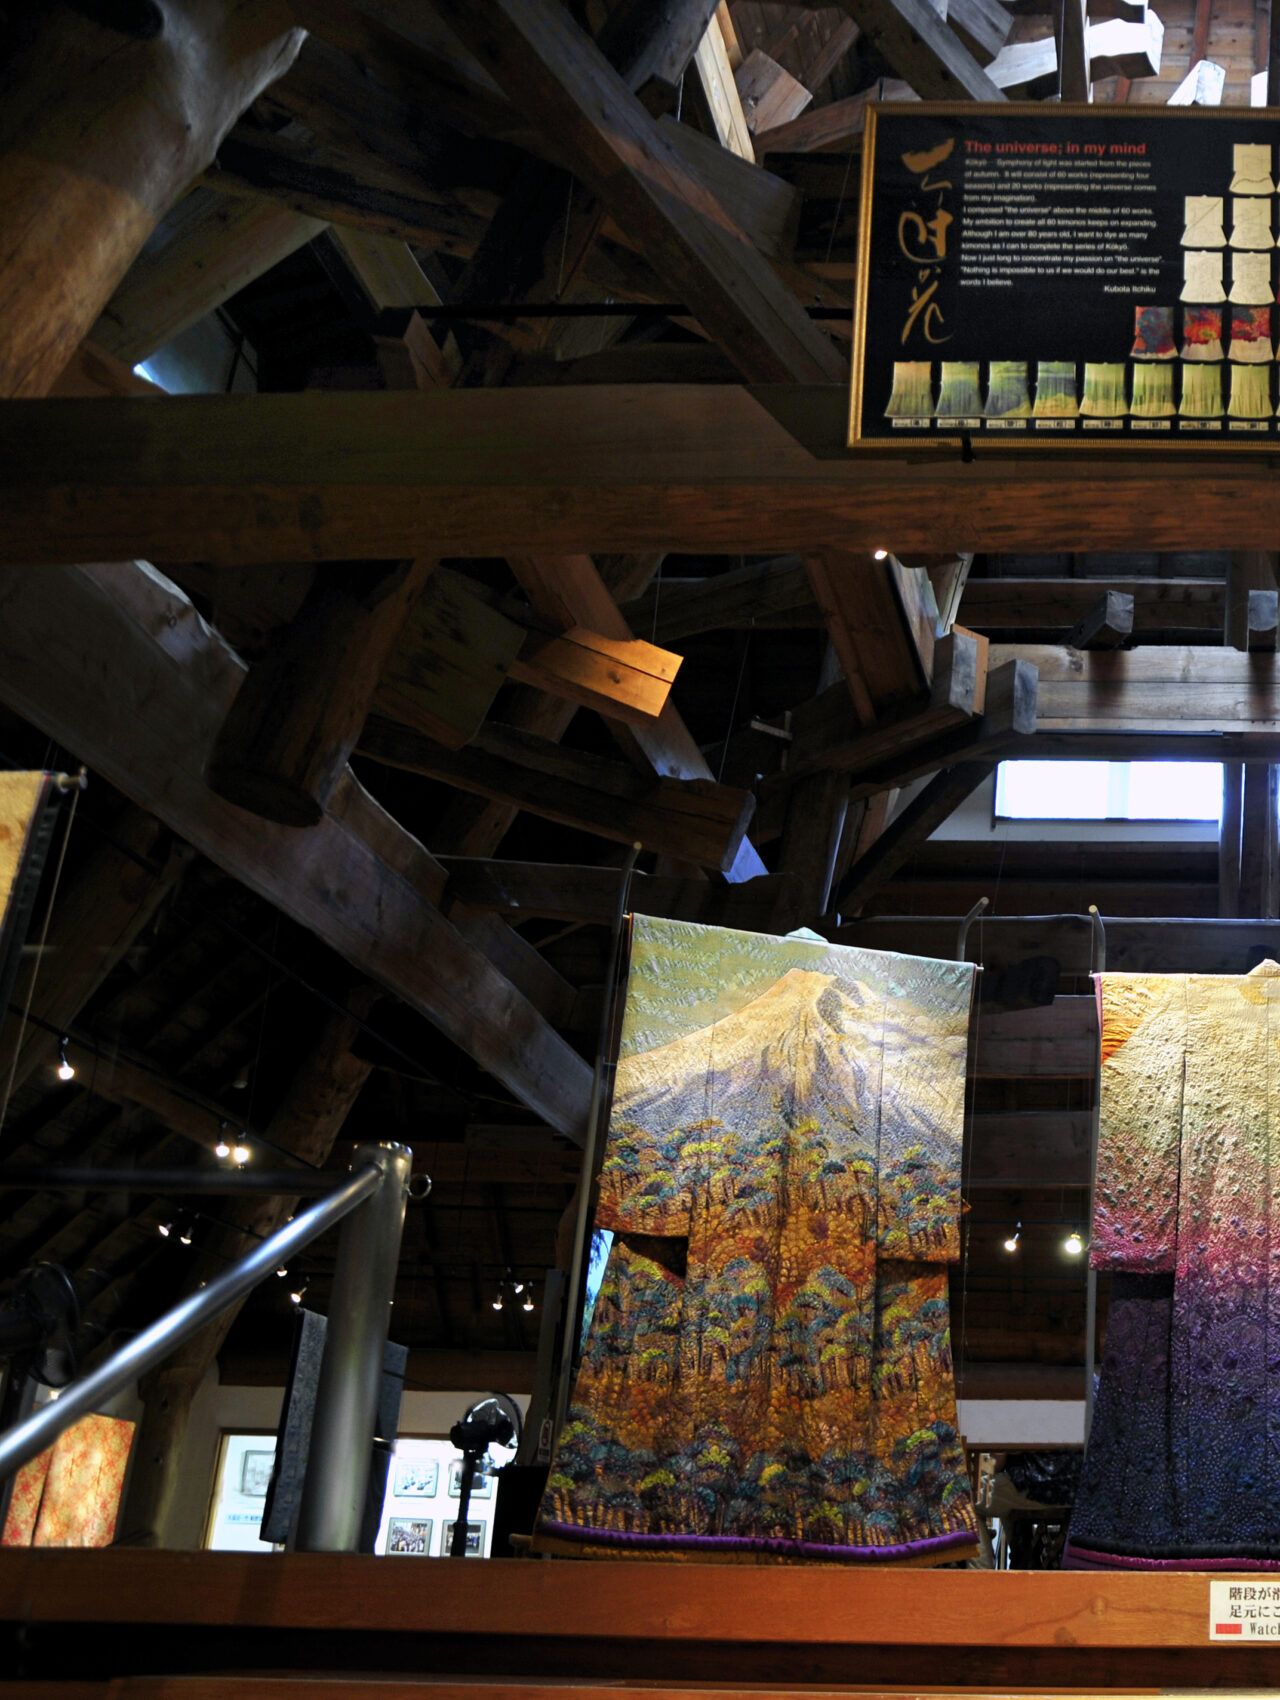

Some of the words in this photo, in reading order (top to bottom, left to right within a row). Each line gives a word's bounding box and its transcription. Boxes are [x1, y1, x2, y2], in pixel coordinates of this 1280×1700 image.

[964, 141, 992, 153] The
[1066, 141, 1080, 153] in
[1083, 144, 1106, 156] my
[1109, 142, 1147, 154] mind
[960, 278, 981, 286] words
[986, 279, 1014, 287] believe.
[1104, 285, 1131, 293] Kubota
[1131, 285, 1156, 293] Itchiku
